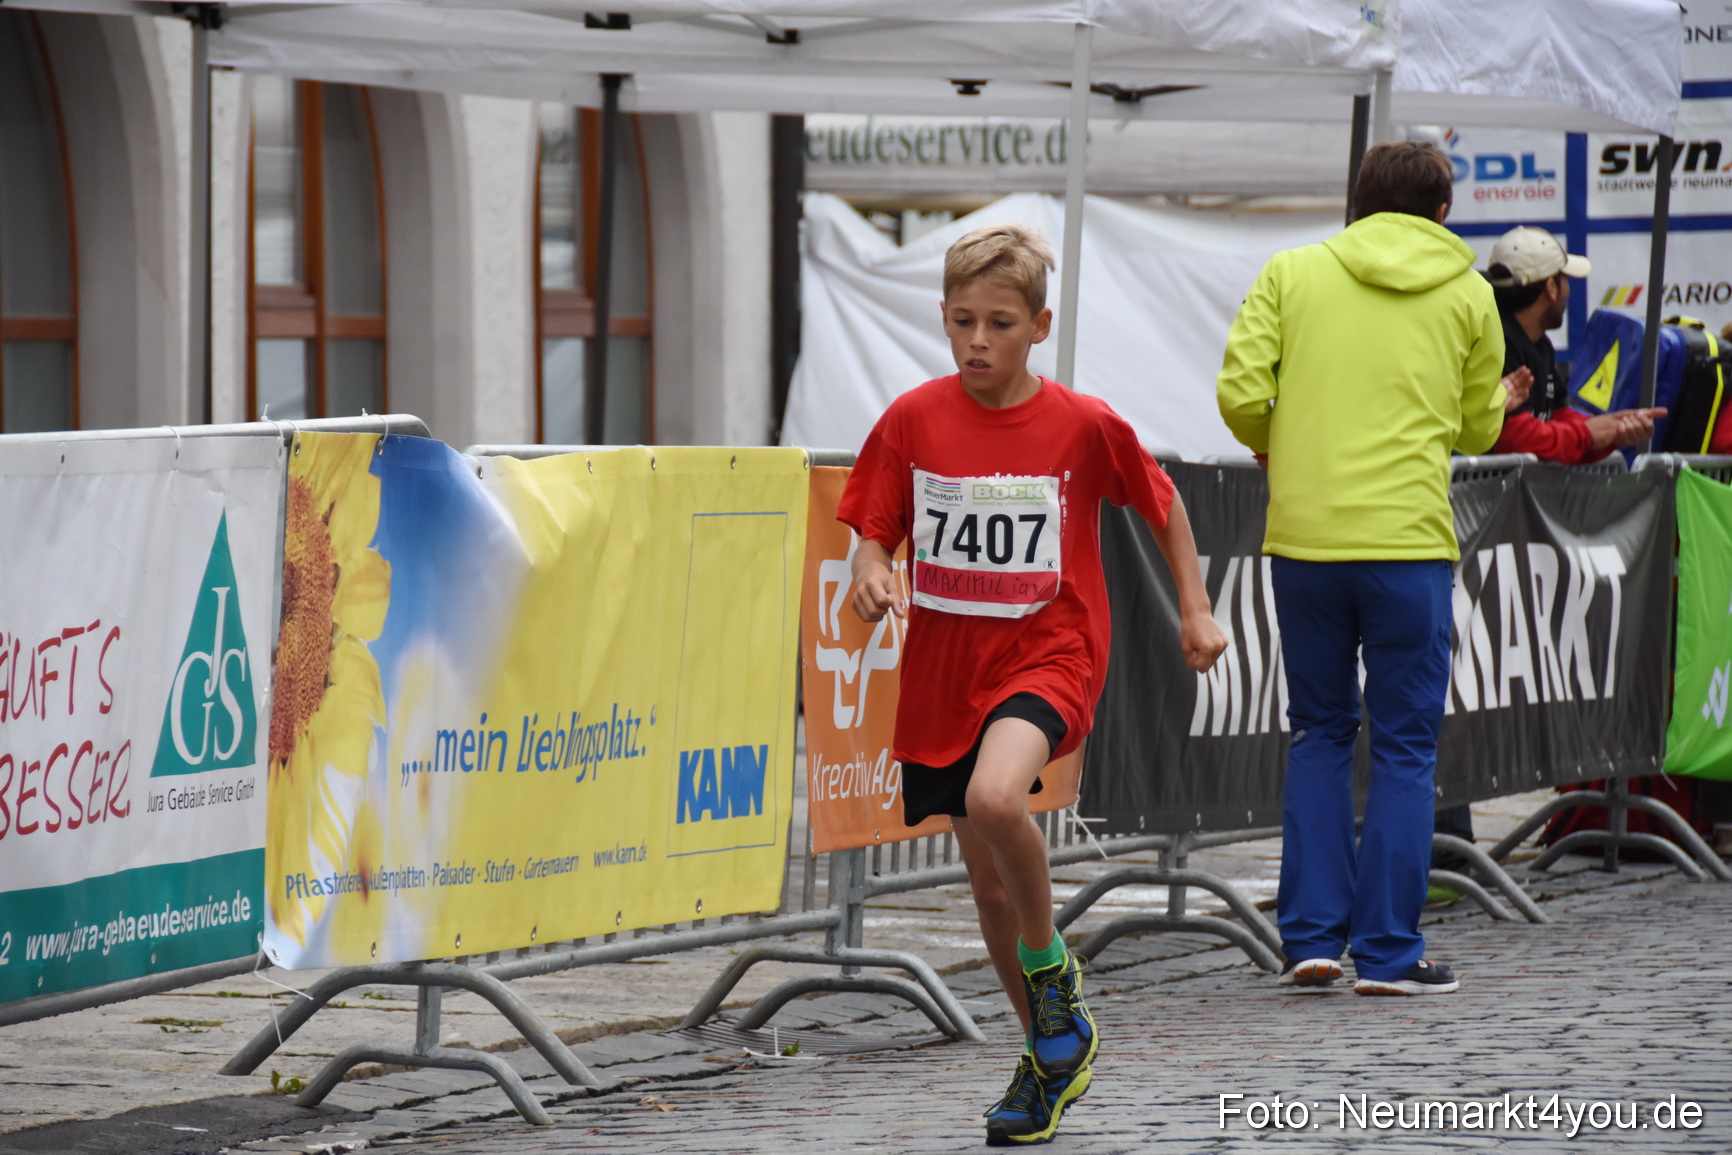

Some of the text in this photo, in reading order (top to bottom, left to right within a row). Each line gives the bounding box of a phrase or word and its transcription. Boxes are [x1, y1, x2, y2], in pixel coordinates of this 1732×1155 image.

[1683, 25, 1732, 43] NE
[1474, 177, 1556, 201] energie
[1597, 176, 1677, 192] stadtwee
[1662, 283, 1732, 304] ARIO
[924, 484, 1047, 502] NeuerMarkt BOCK
[926, 508, 1047, 565] 7407
[1047, 560, 1054, 569] K
[676, 744, 768, 824] KANN
[812, 748, 903, 810] KreativAg
[147, 777, 255, 813] Jura Gebäude Service GmbH
[26, 890, 250, 963] www.jura-gebaeudeservice.de
